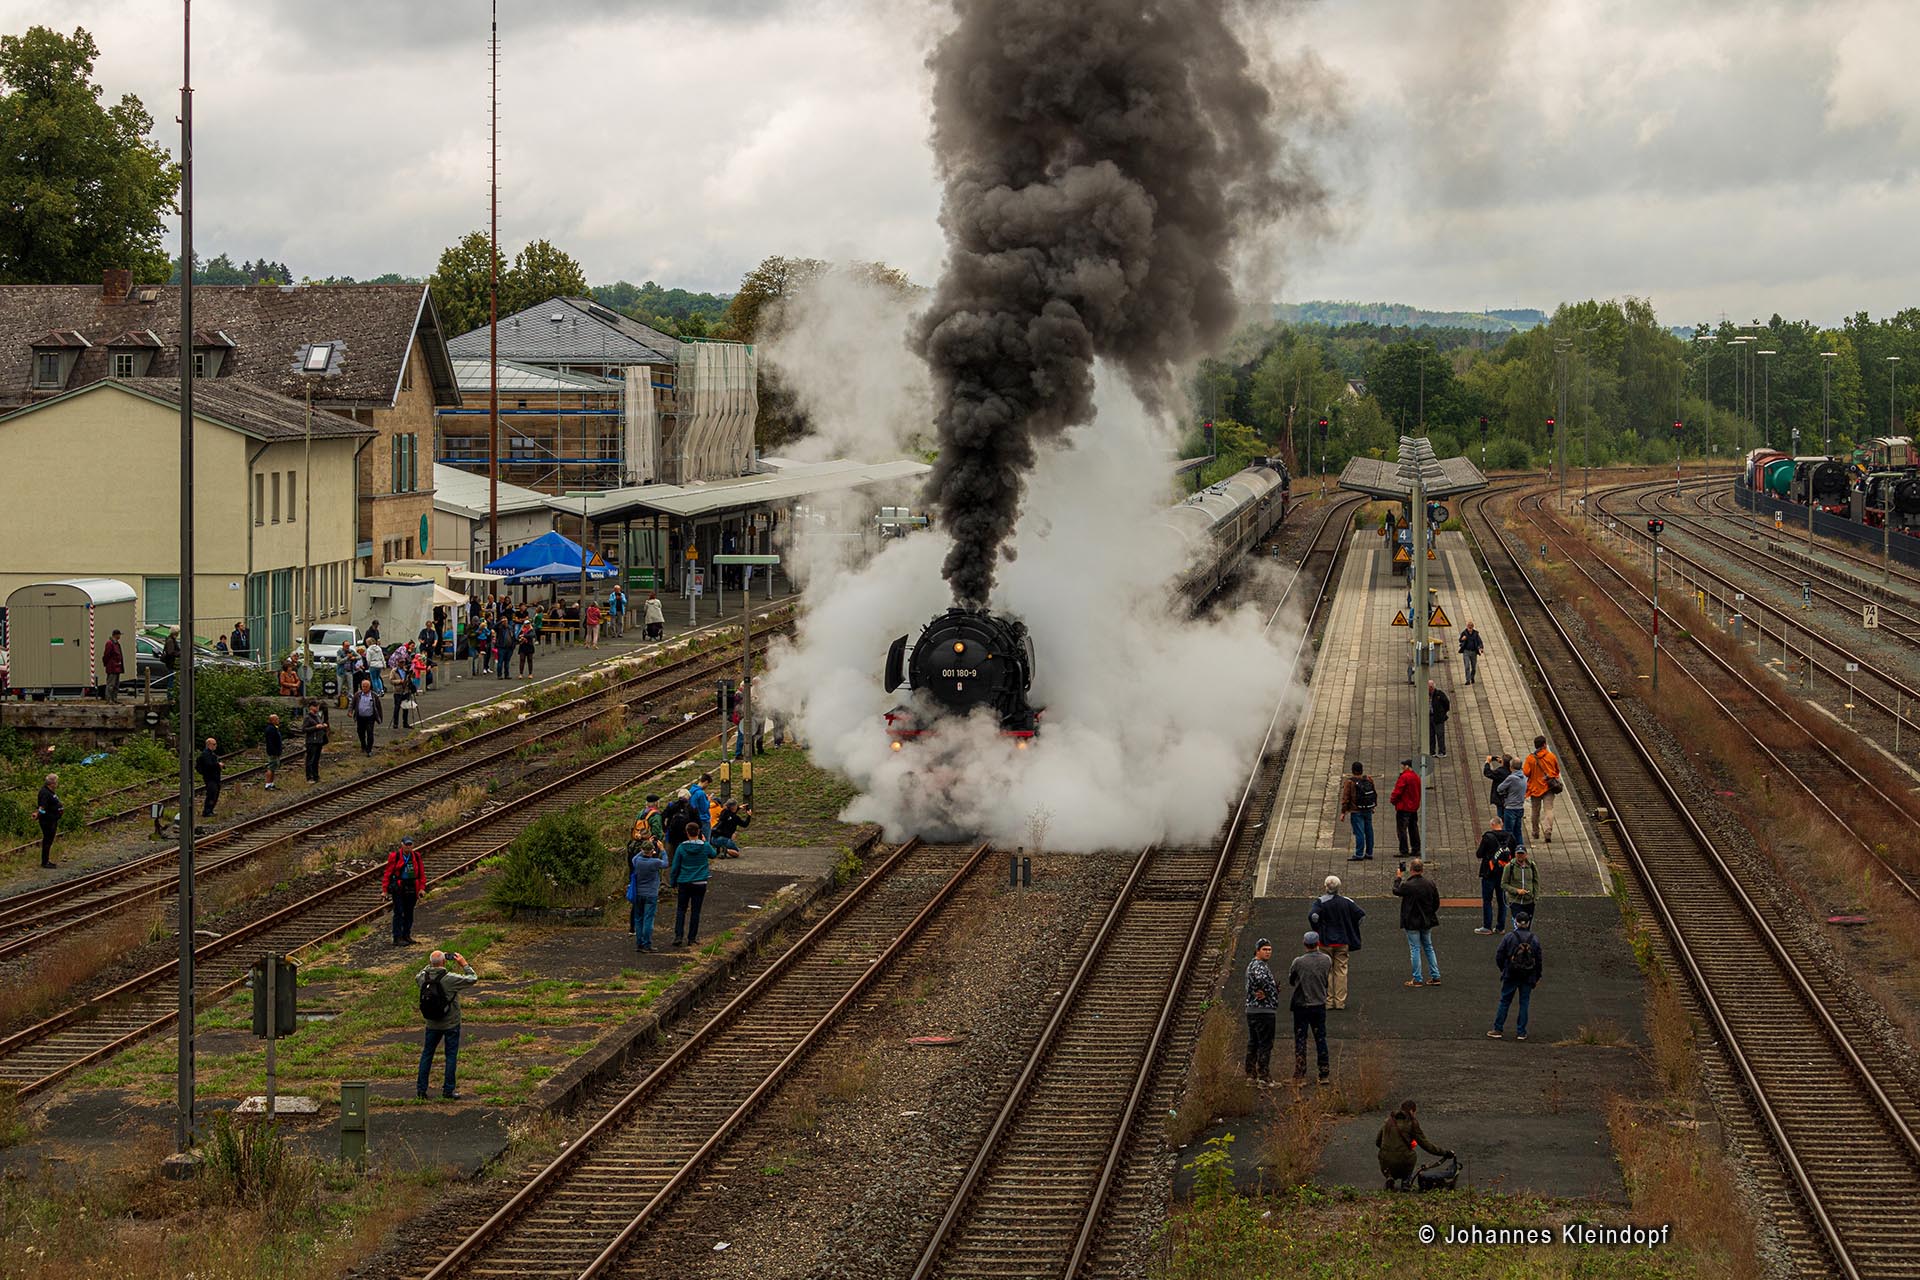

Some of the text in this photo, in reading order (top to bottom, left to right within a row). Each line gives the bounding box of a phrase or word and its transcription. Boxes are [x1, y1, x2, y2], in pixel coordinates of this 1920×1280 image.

[1400, 529, 1407, 540] 4
[729, 536, 735, 548] 1
[1865, 606, 1876, 616] 74
[1867, 616, 1874, 625] 4
[942, 669, 977, 677] 001 180-9
